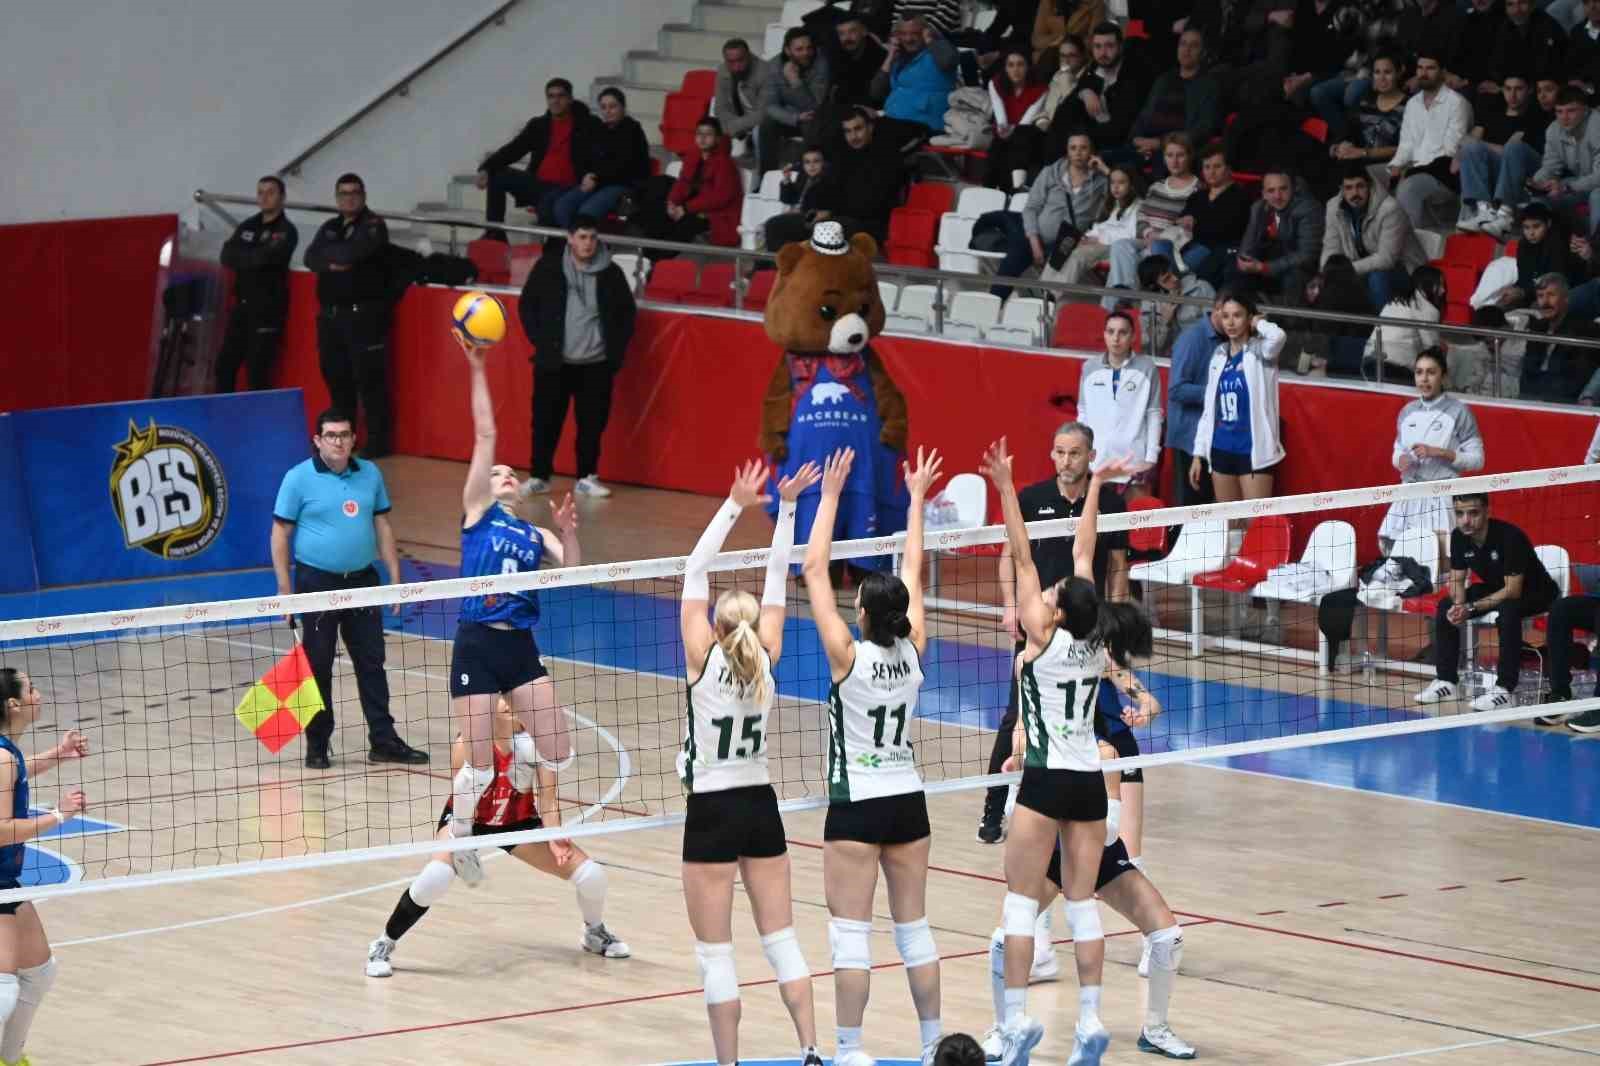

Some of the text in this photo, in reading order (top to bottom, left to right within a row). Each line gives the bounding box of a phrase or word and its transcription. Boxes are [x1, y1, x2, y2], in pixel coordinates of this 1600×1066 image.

[1220, 391, 1238, 421] 19
[118, 448, 203, 544] BES
[491, 536, 534, 562] VitrA
[481, 581, 494, 589] TVF
[461, 674, 470, 686] 9
[1056, 676, 1099, 720] 17
[711, 714, 762, 760] 15
[867, 702, 907, 748] 11
